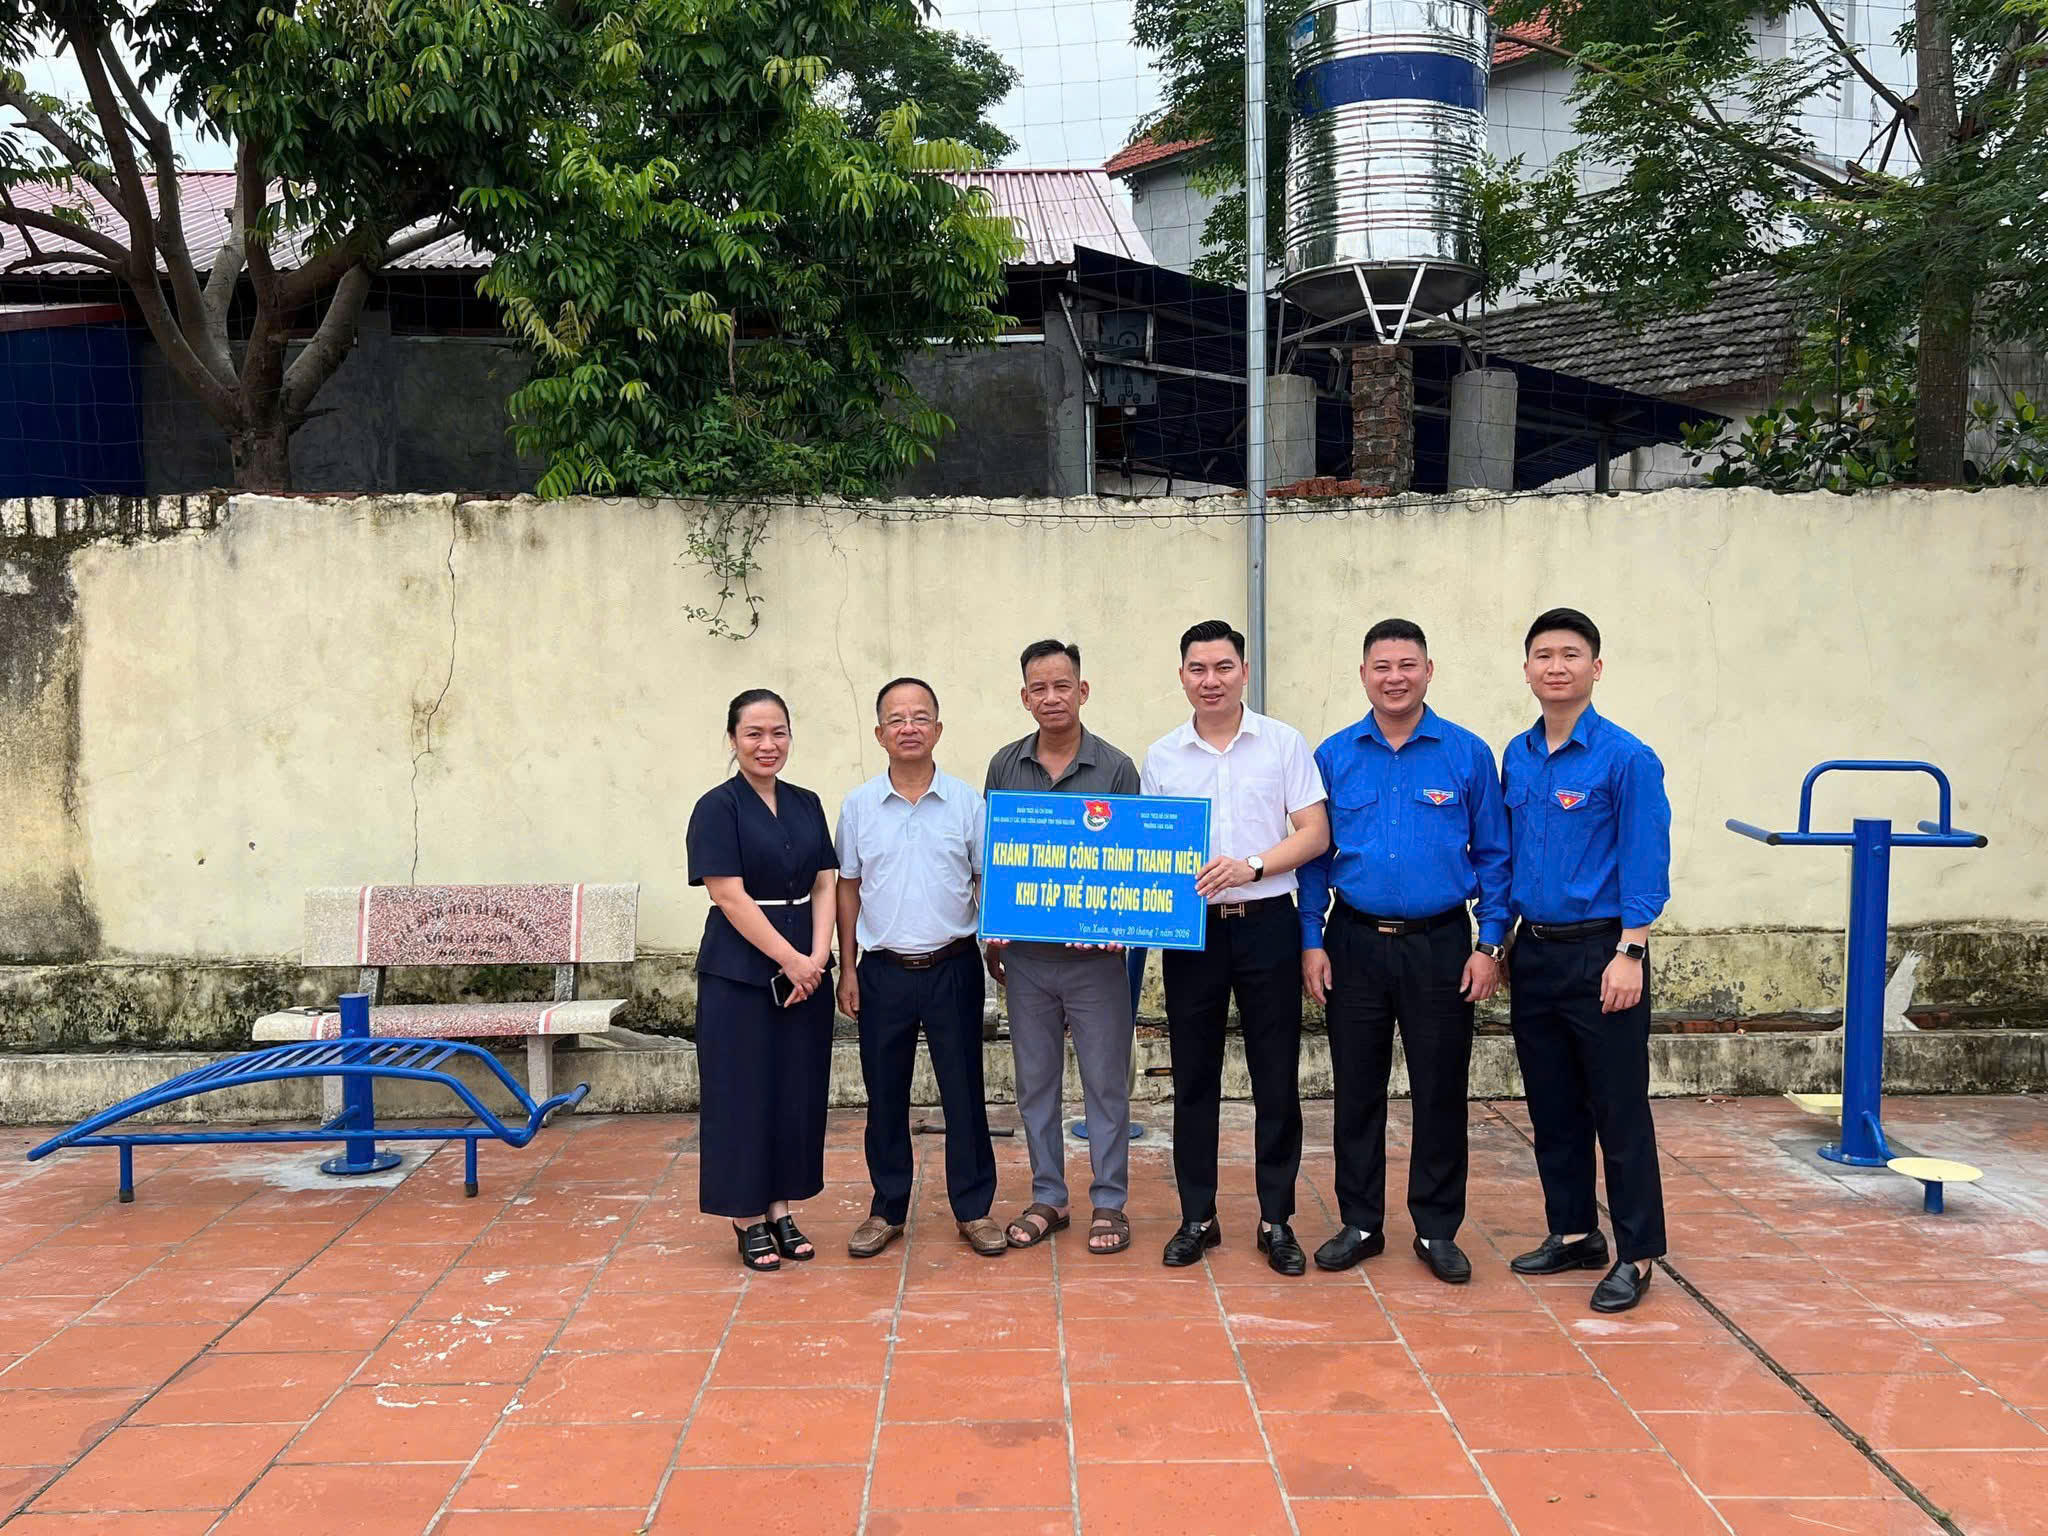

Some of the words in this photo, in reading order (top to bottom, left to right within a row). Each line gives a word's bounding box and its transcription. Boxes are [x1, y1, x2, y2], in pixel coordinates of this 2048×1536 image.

[992, 838, 1029, 867] KHÁNH
[1032, 840, 1067, 868] THÀNH
[1069, 841, 1099, 870] CÔNG
[1102, 842, 1134, 872] TRÌNH
[1136, 848, 1172, 873] THANH
[1174, 846, 1202, 875] NIÊN
[1015, 882, 1038, 906] KHU
[1040, 878, 1061, 912] TẬP
[1063, 875, 1085, 909] THỂ
[1085, 885, 1107, 915] DỤC
[1110, 881, 1140, 916] CỘNG
[1126, 925, 1136, 936] 20
[1154, 927, 1160, 937] 7
